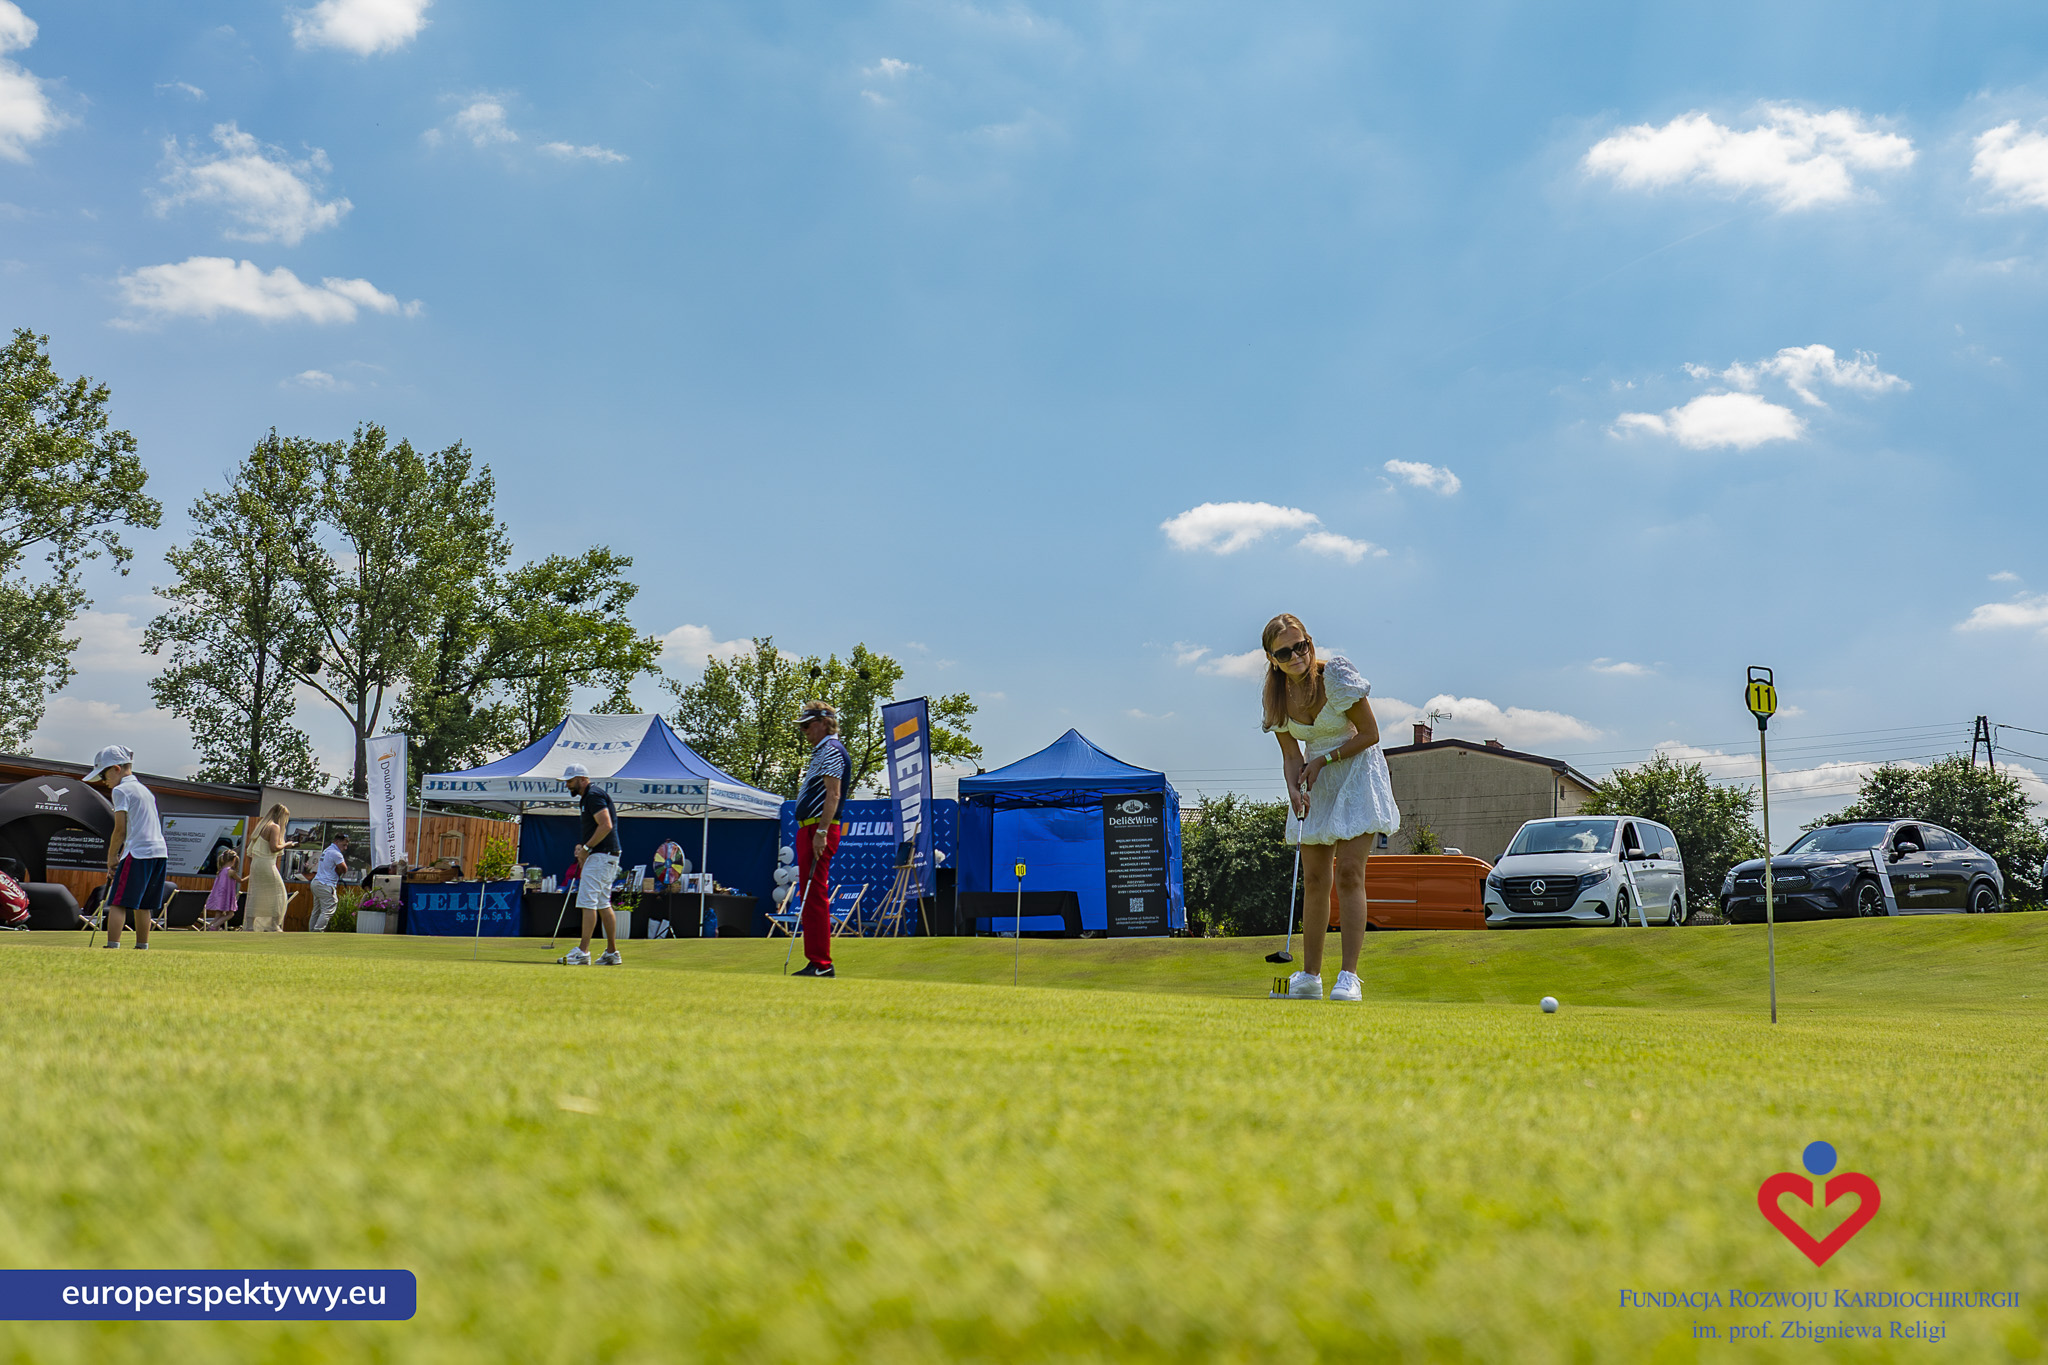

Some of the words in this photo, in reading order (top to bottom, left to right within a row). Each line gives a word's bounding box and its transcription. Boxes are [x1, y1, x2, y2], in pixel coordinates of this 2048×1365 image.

[1755, 685, 1772, 711] 11
[557, 740, 635, 751] JELUX
[425, 780, 488, 792] JELUX
[508, 780, 622, 794] WWW.JEPL
[639, 783, 705, 795] JELUX
[1108, 815, 1159, 826] Deli&Wine
[849, 821, 894, 836] JELUX
[1017, 865, 1025, 875] 10
[412, 892, 511, 911] JELUX
[456, 911, 468, 922] Sp.
[492, 911, 503, 923] Sp.
[1278, 978, 1288, 994] 11
